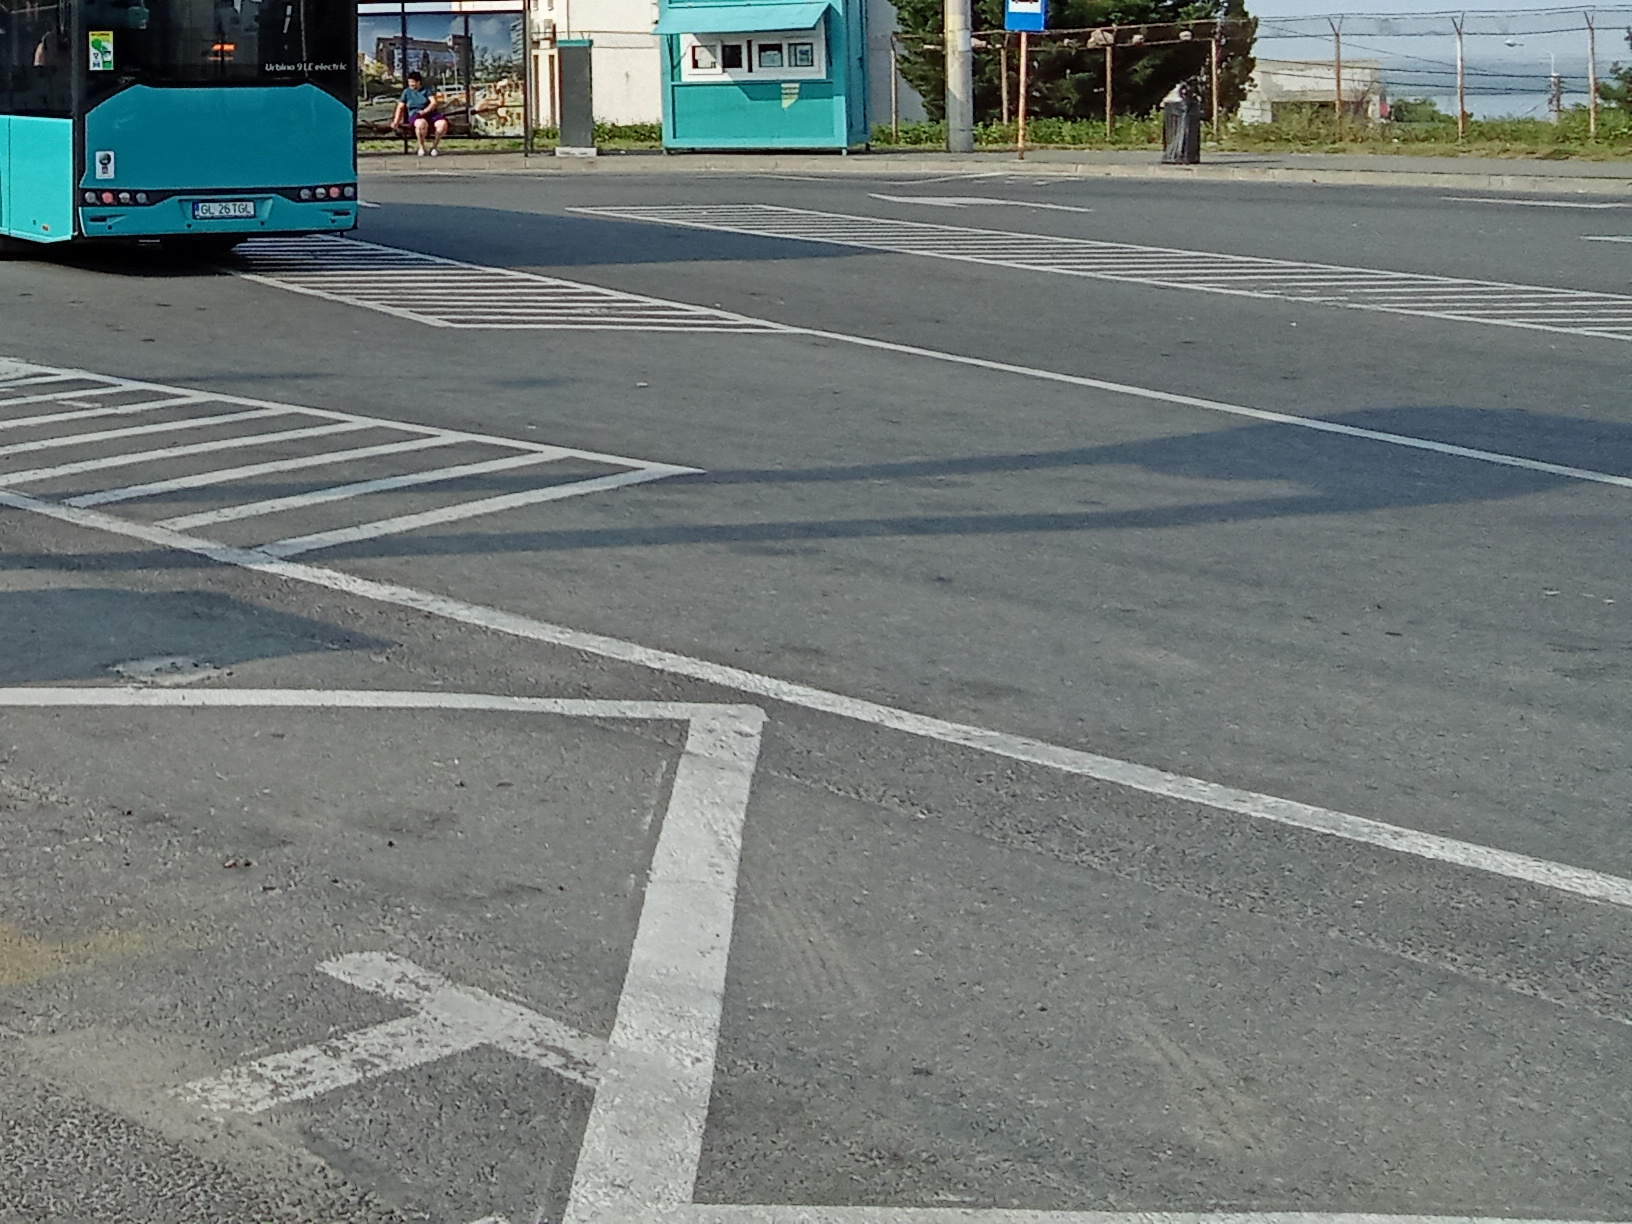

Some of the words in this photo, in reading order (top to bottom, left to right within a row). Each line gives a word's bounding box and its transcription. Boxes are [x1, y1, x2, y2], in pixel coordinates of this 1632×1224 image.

[265, 62, 295, 71] Urbino
[296, 62, 303, 71] 9
[314, 61, 347, 71] electric
[200, 204, 215, 215] GL
[218, 203, 231, 214] 26
[232, 203, 251, 214] TGL
